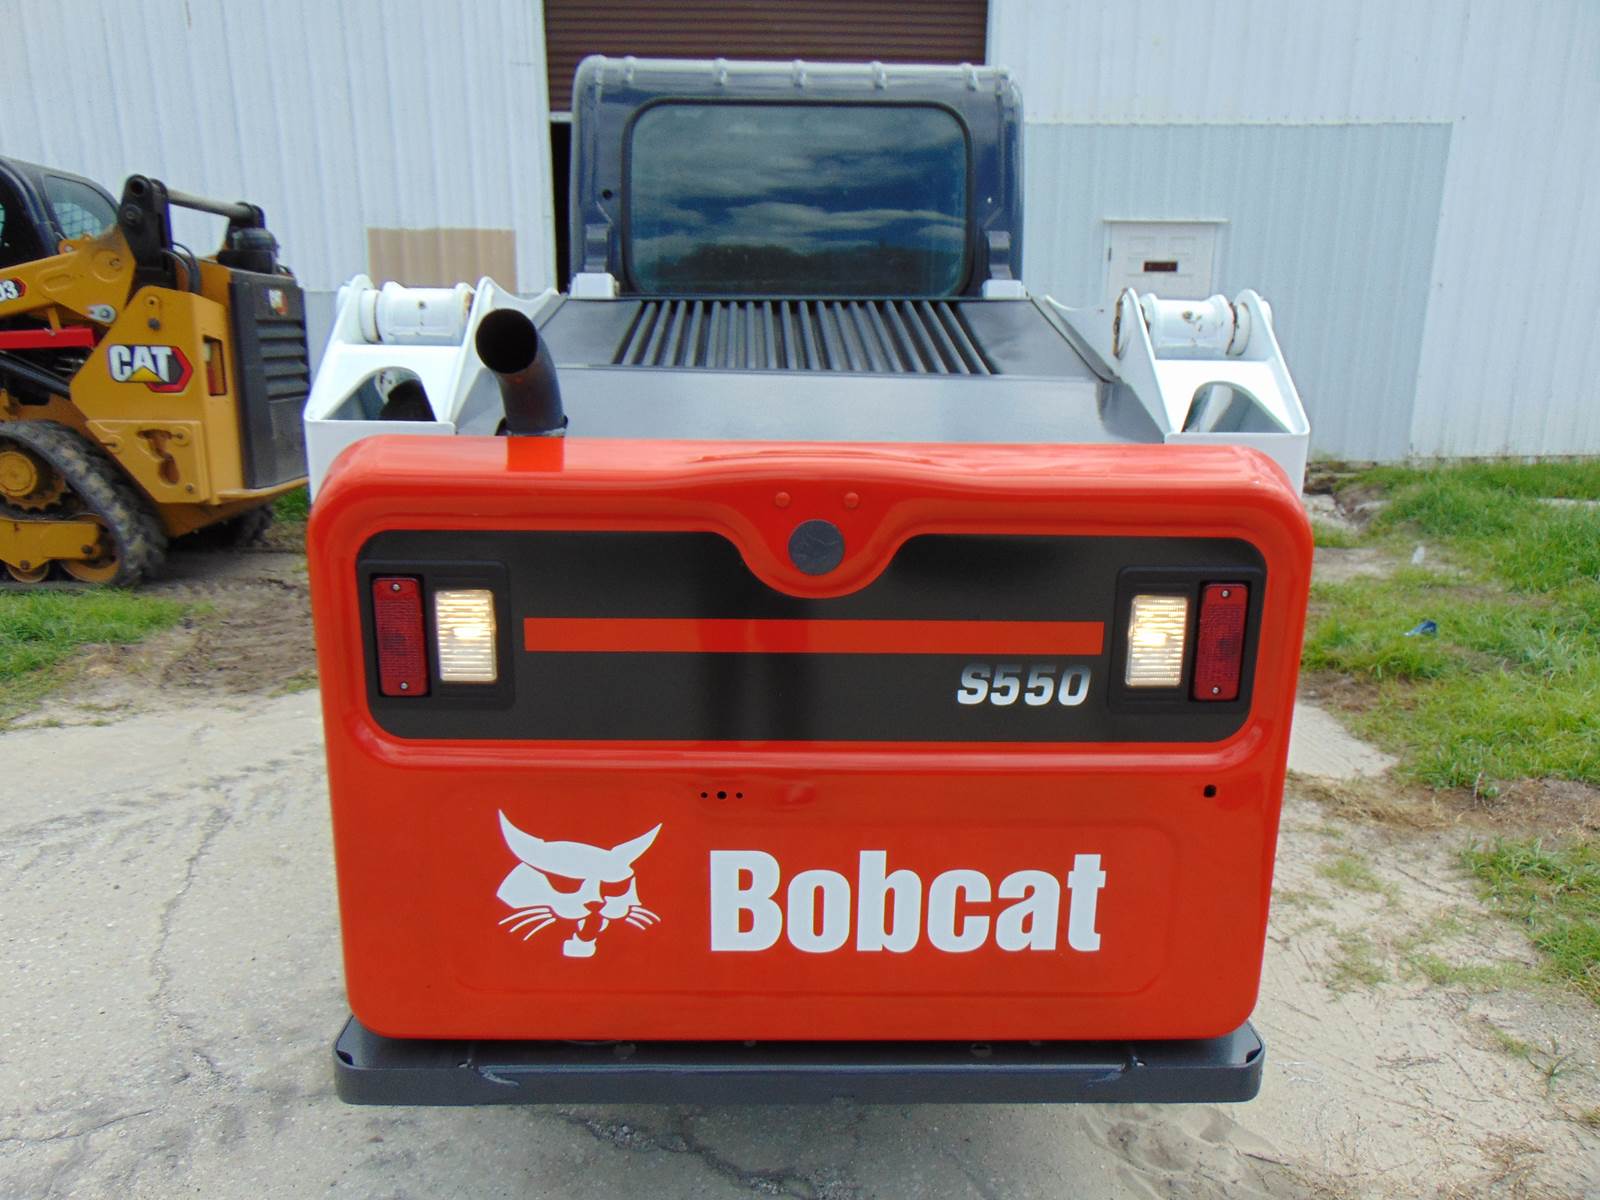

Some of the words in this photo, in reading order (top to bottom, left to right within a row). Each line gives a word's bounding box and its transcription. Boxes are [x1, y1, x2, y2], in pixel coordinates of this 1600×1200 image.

[109, 345, 172, 383] CAT
[957, 663, 1092, 706] S550
[710, 850, 1107, 953] Bobcat
